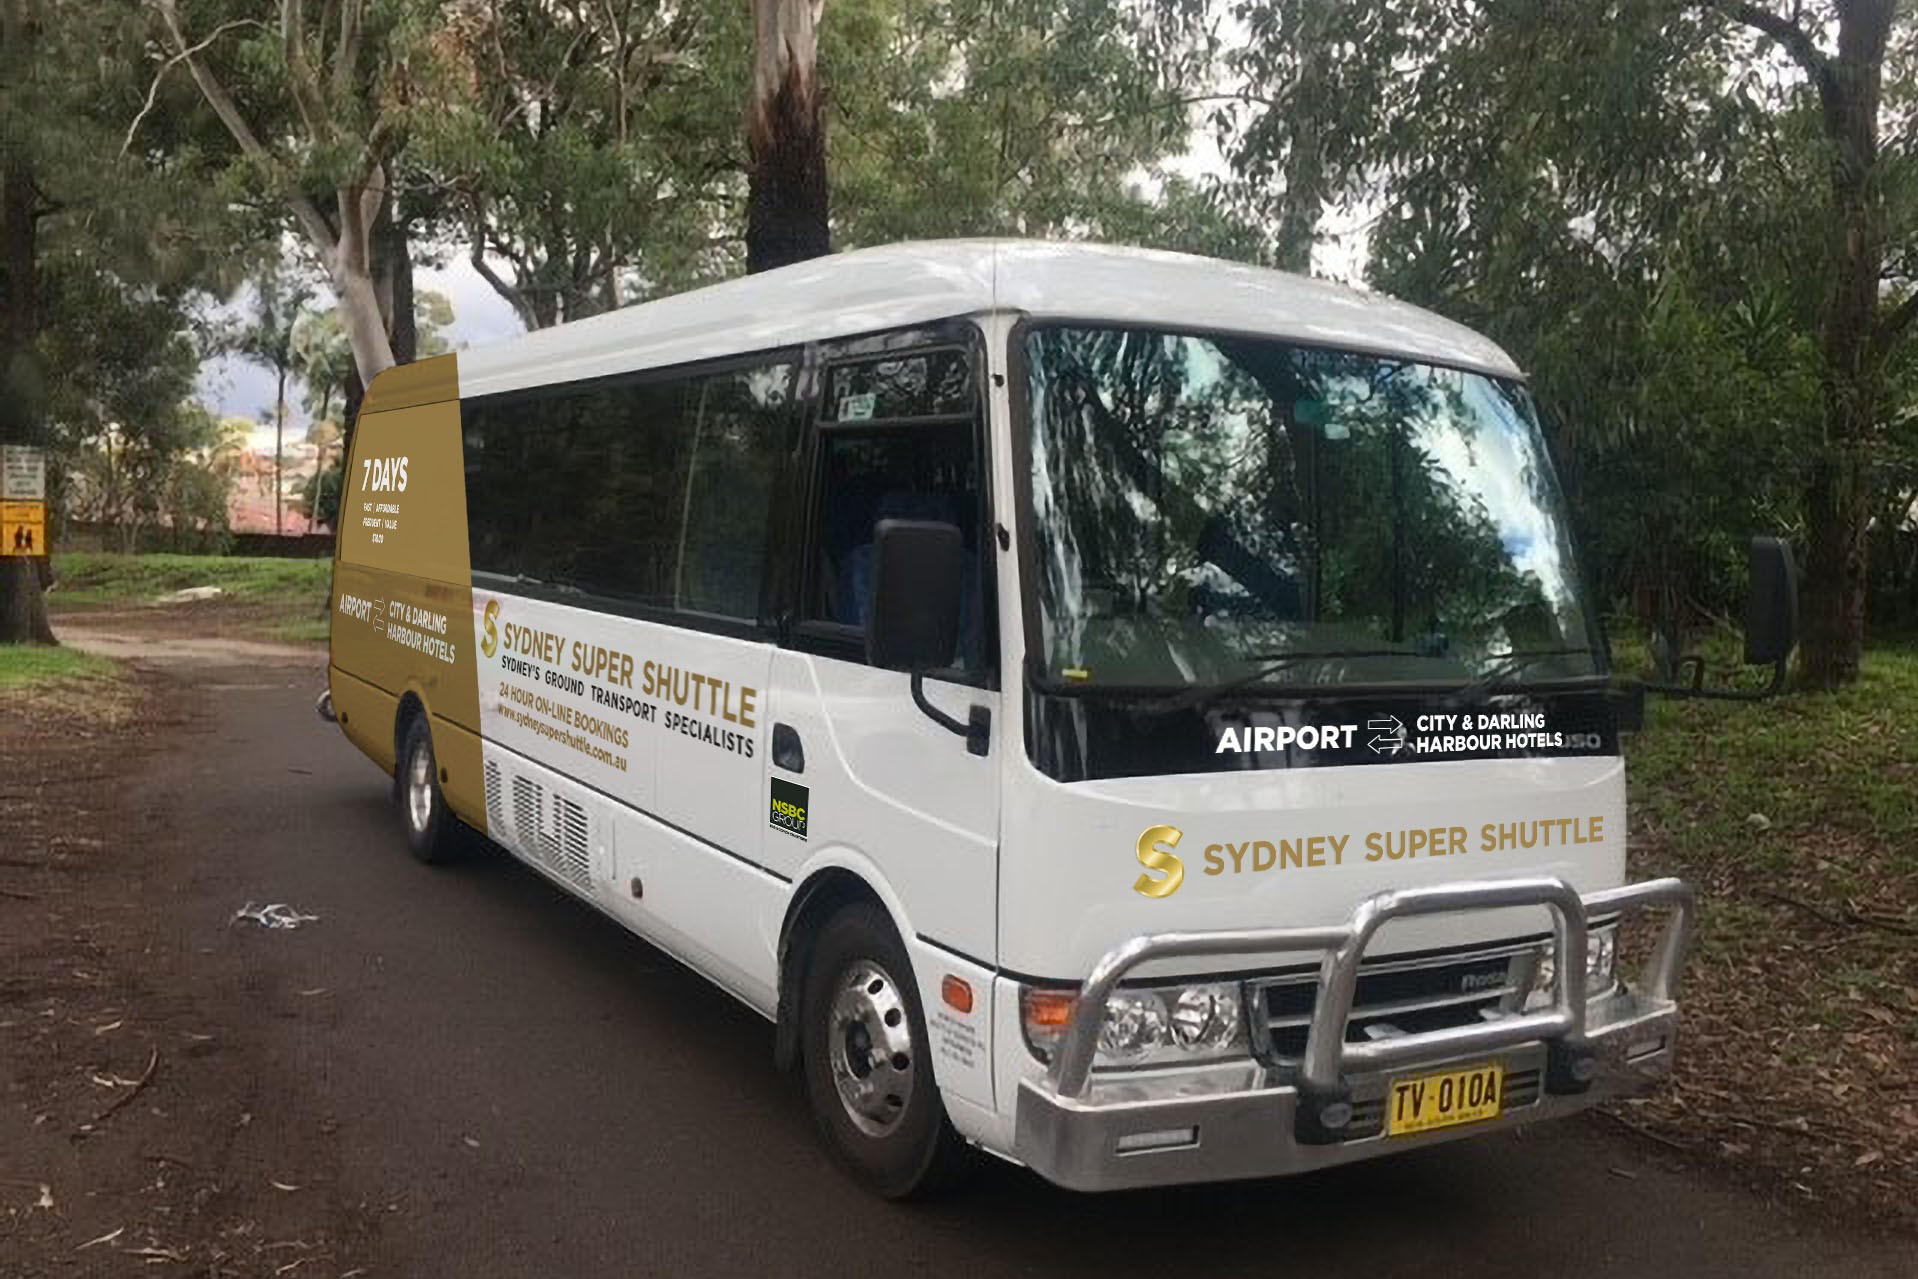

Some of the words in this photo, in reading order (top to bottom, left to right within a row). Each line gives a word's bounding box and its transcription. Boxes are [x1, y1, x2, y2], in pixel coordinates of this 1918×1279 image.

[361, 459, 371, 491] 7
[372, 456, 408, 492] DAYS
[339, 593, 372, 623] AIRPORT
[389, 600, 405, 621] CITY
[405, 605, 412, 623] &
[412, 607, 447, 635] DARLING
[386, 622, 422, 652] HARBOUR
[422, 634, 455, 664] HOTELS
[503, 622, 566, 666] SYDNEY
[571, 640, 634, 689] SUPER
[642, 660, 758, 729] SHUTTLE
[499, 681, 509, 697] 24
[510, 686, 534, 709] HOUR
[535, 696, 573, 726] ON-LINE
[574, 711, 629, 748] BOOKINGS
[501, 655, 540, 681] SYDNEY'S
[545, 670, 585, 697] GROUND
[591, 685, 657, 723] TRANSPORT
[664, 711, 754, 758] SPECIALISTS
[1416, 715, 1458, 732] CITY
[1462, 715, 1474, 731] &
[1477, 714, 1546, 730] DARLING
[498, 703, 628, 772] www.sydneysupershuttle.com.au
[1215, 725, 1358, 754] AIRPORT
[1416, 735, 1502, 754] HARBOUR
[1505, 732, 1563, 749] HOTELS
[772, 798, 806, 821] NSBC
[772, 810, 806, 831] GROUP
[1203, 834, 1350, 876] SYDNEY
[1364, 826, 1468, 862] SUPER
[1480, 816, 1604, 852] SHUTTLE
